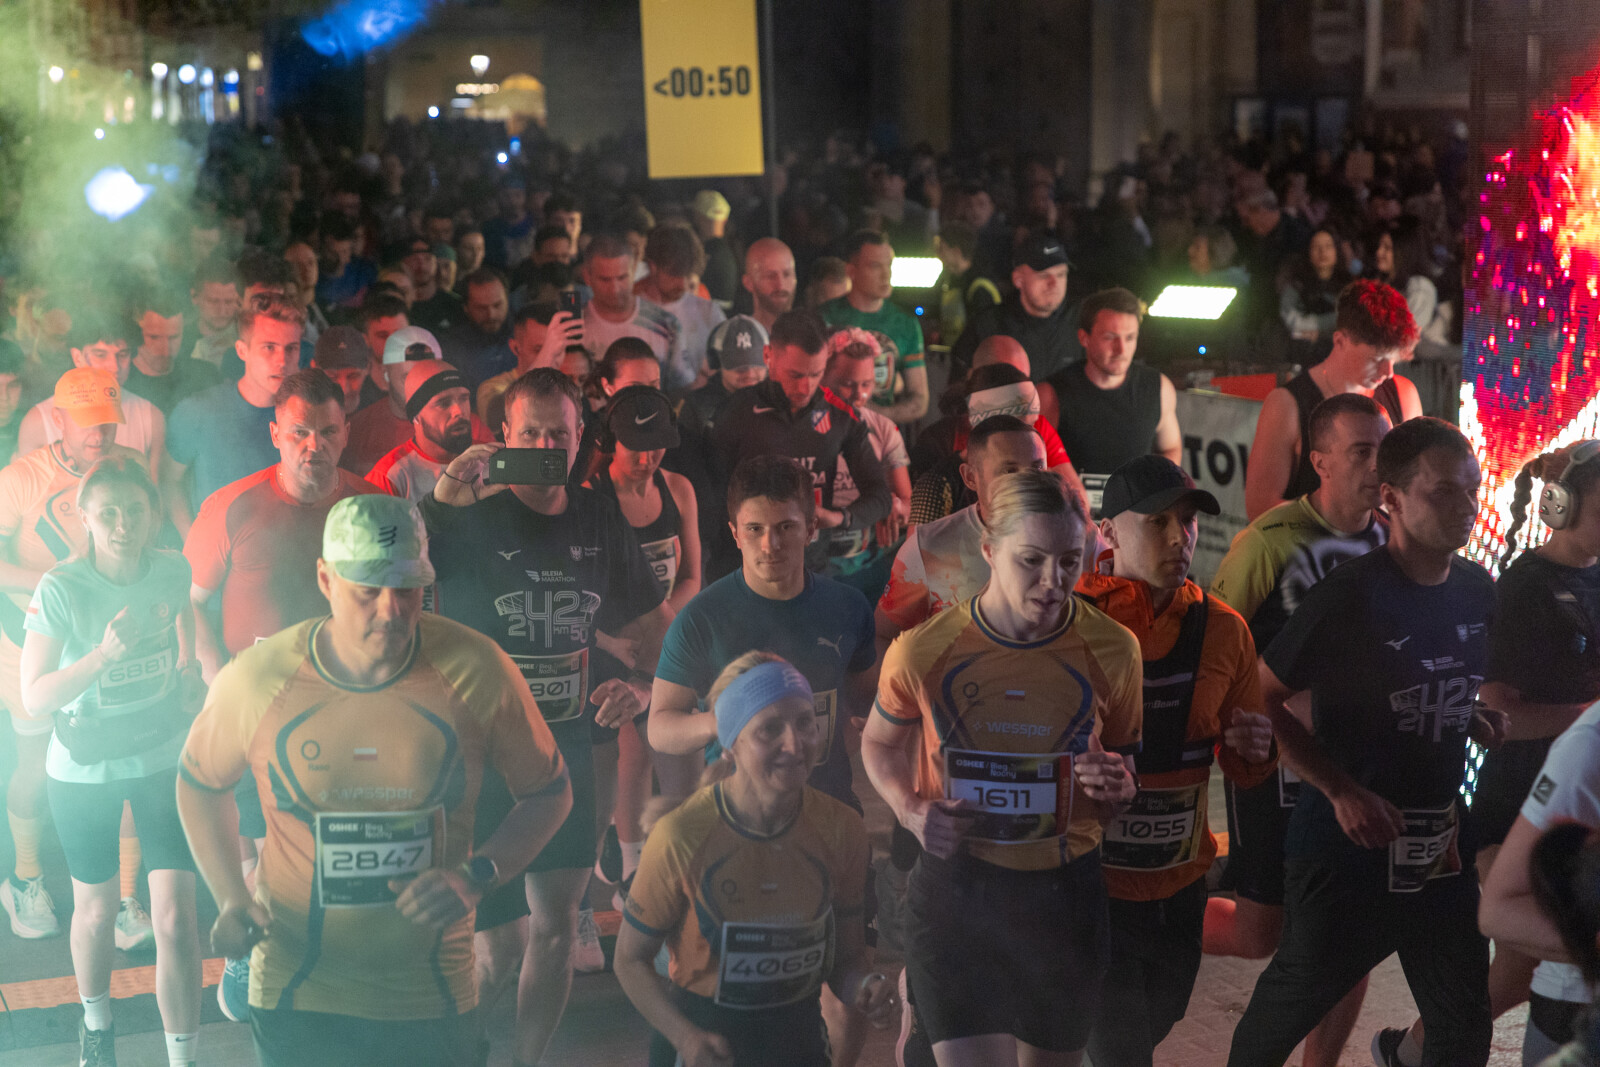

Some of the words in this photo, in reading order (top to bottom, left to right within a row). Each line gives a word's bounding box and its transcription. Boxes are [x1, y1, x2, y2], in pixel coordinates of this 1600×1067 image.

[653, 66, 751, 98] <00:50
[109, 655, 167, 682] 6881
[529, 680, 571, 697] 801
[986, 721, 1053, 738] wessper
[955, 758, 986, 768] OSHEE
[989, 761, 1009, 773] Bieg
[989, 769, 1018, 780] Nocny
[973, 786, 1031, 809] 1611
[1118, 818, 1187, 839] 1055
[331, 845, 425, 871] 2847
[730, 950, 823, 976] 4069
